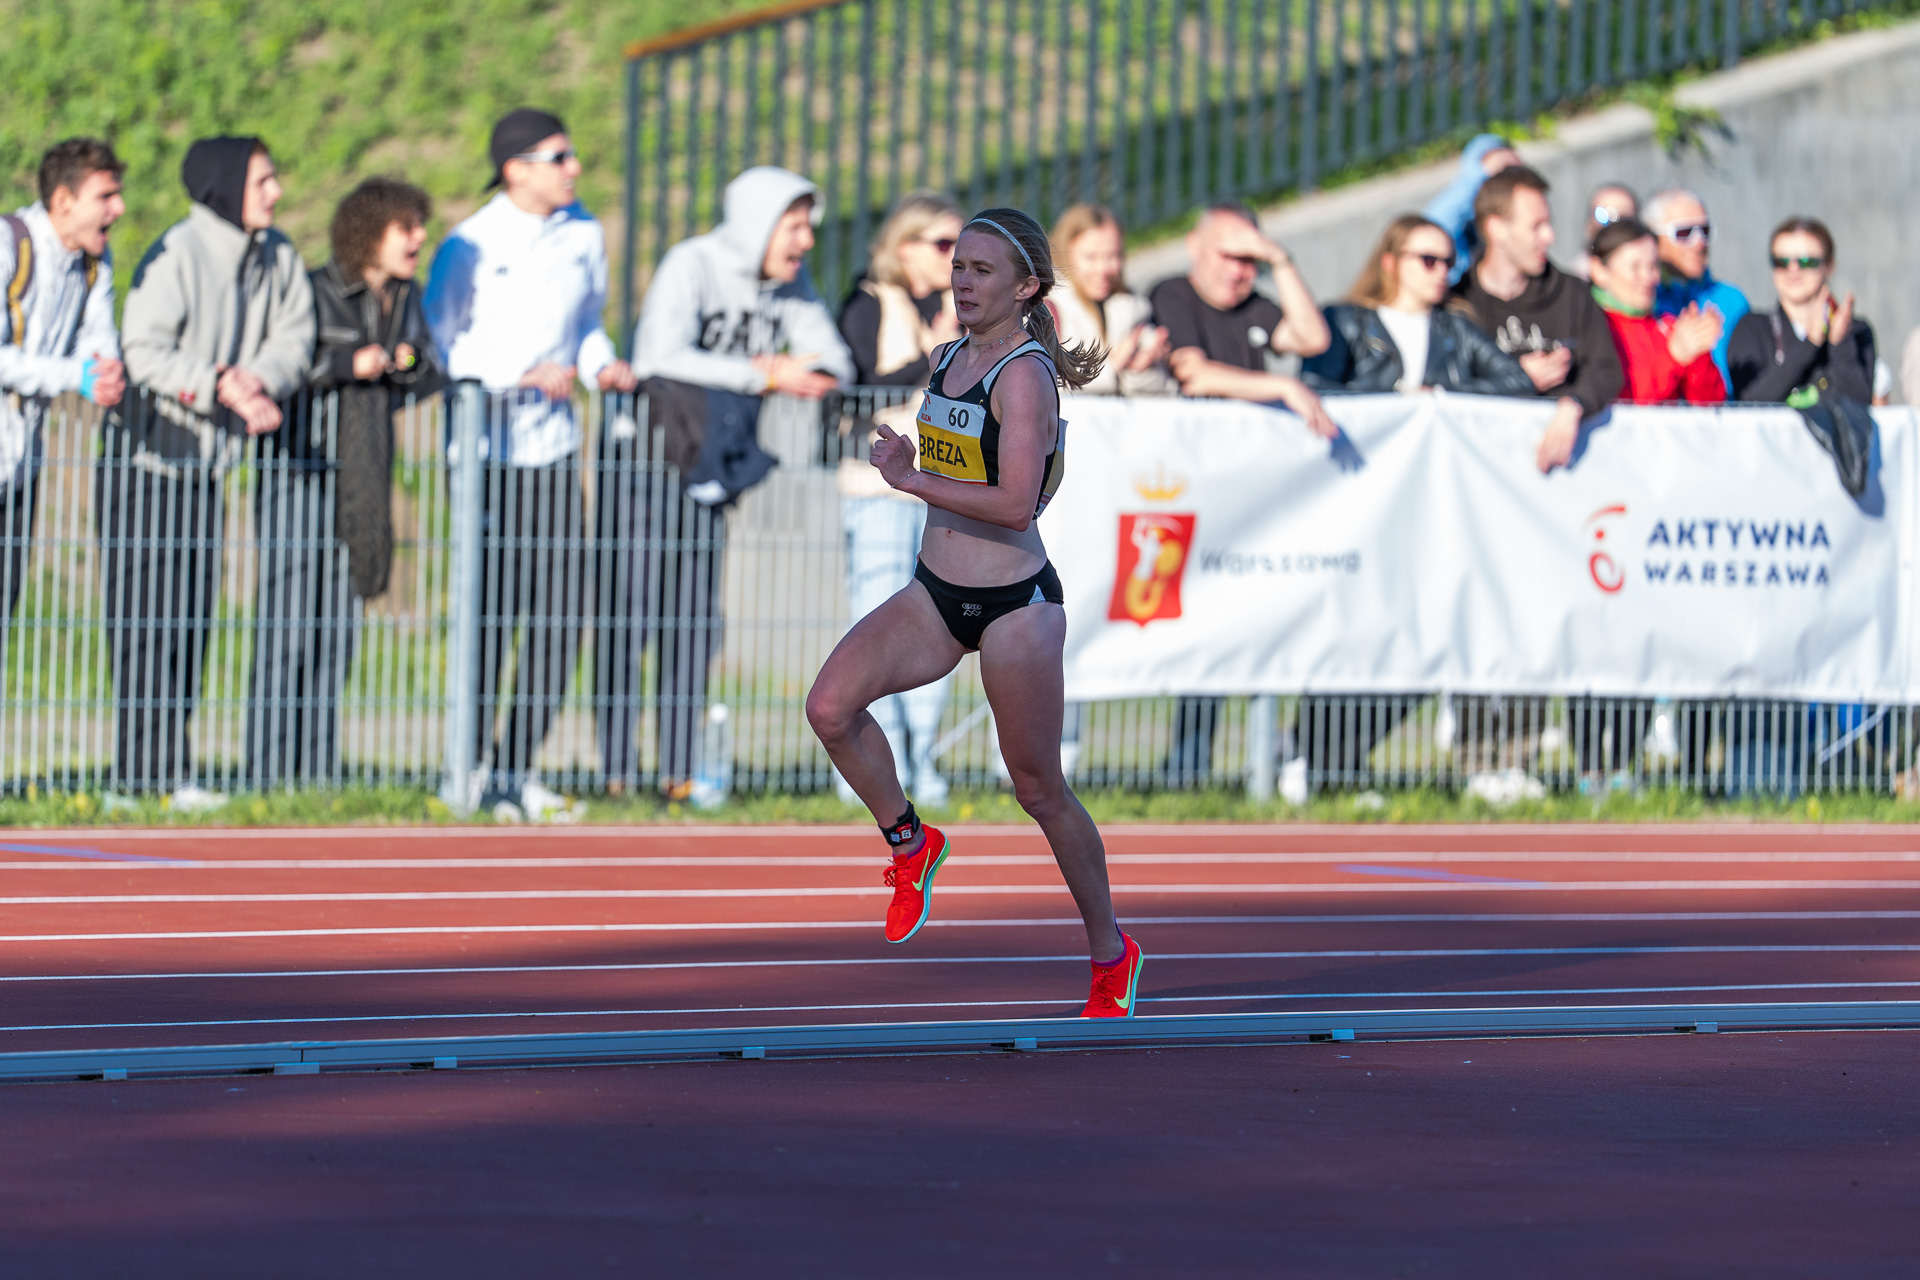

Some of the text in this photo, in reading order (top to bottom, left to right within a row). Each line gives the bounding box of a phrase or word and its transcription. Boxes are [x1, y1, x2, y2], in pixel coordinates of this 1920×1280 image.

[948, 406, 970, 429] 60
[918, 433, 967, 468] BREZA
[1648, 518, 1831, 549] AKTYWNA
[1644, 560, 1831, 585] WARSZAWA
